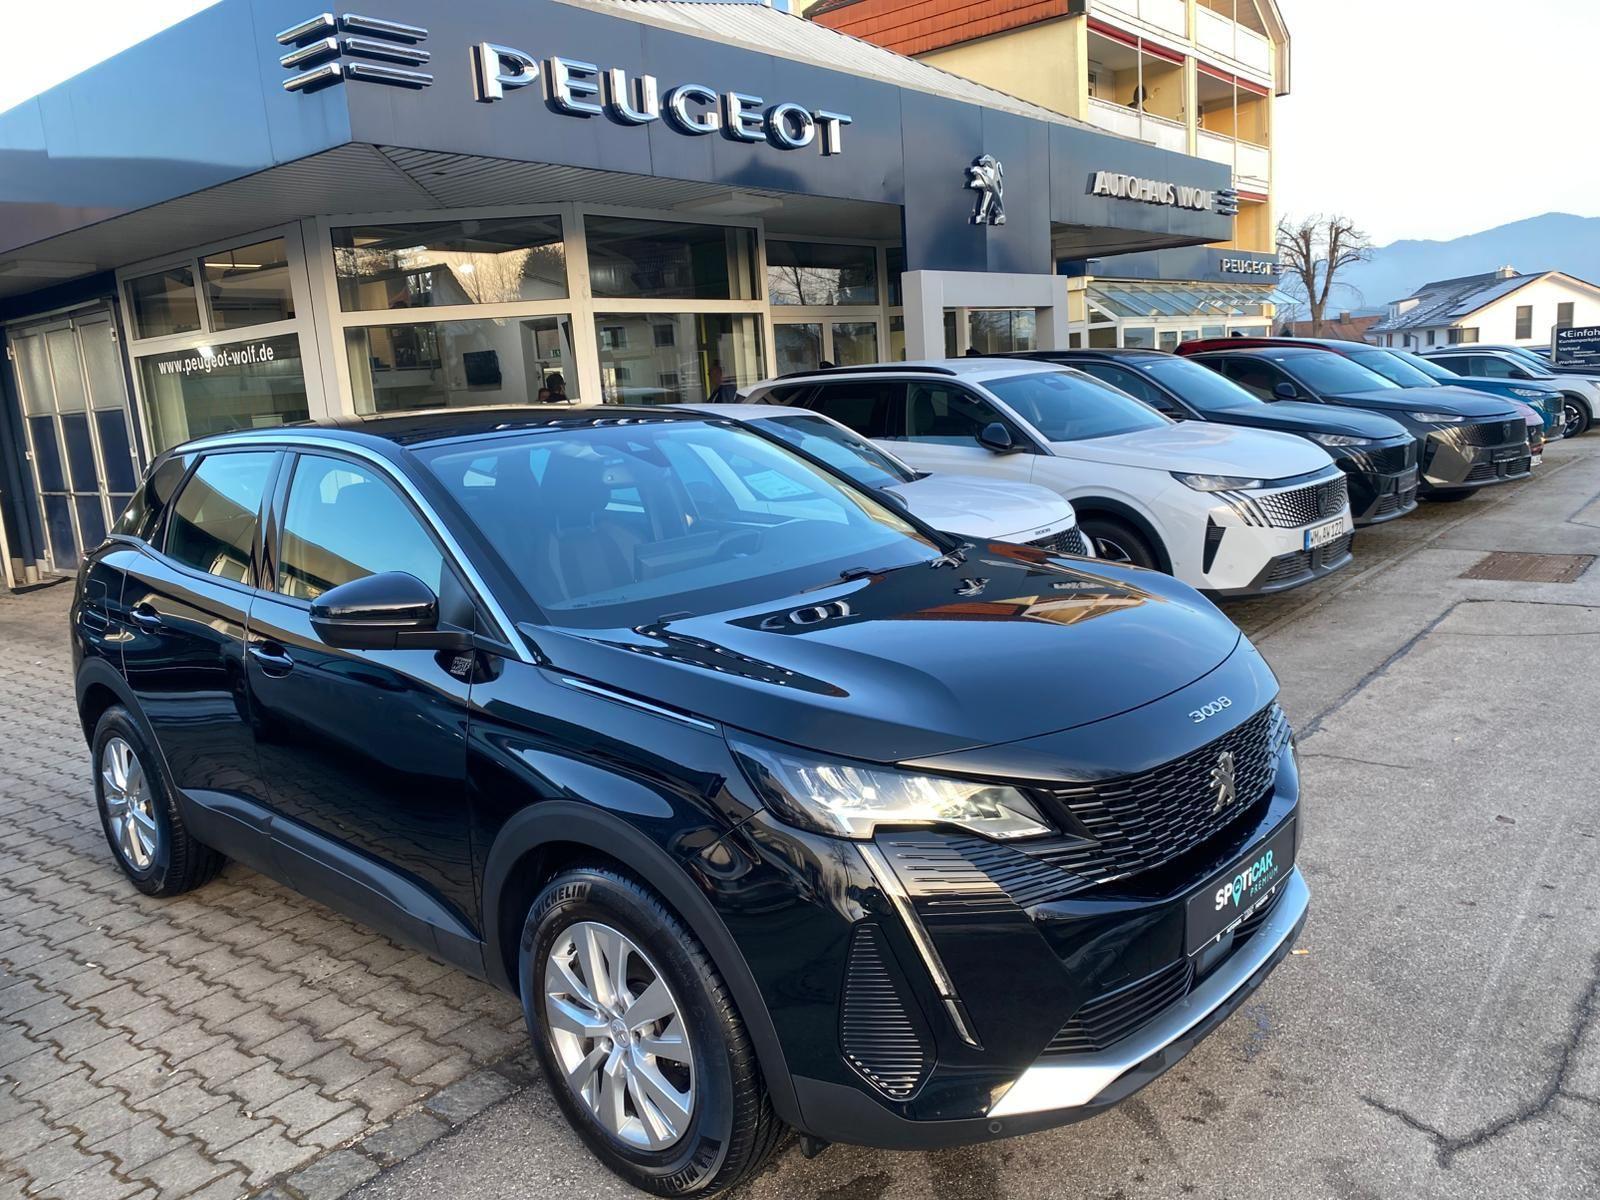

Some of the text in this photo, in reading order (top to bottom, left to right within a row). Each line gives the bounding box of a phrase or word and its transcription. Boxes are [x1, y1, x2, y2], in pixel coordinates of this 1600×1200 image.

[470, 41, 852, 156] PEUGEOT
[1091, 171, 1215, 211] AUTOHAUS WOLF
[1222, 258, 1273, 275] PEUGEOT
[158, 344, 274, 375] www.peugeot-wolf.de
[1188, 696, 1232, 723] 3008
[1249, 865, 1278, 897] PREMIUM
[531, 884, 588, 922] MICHELIN
